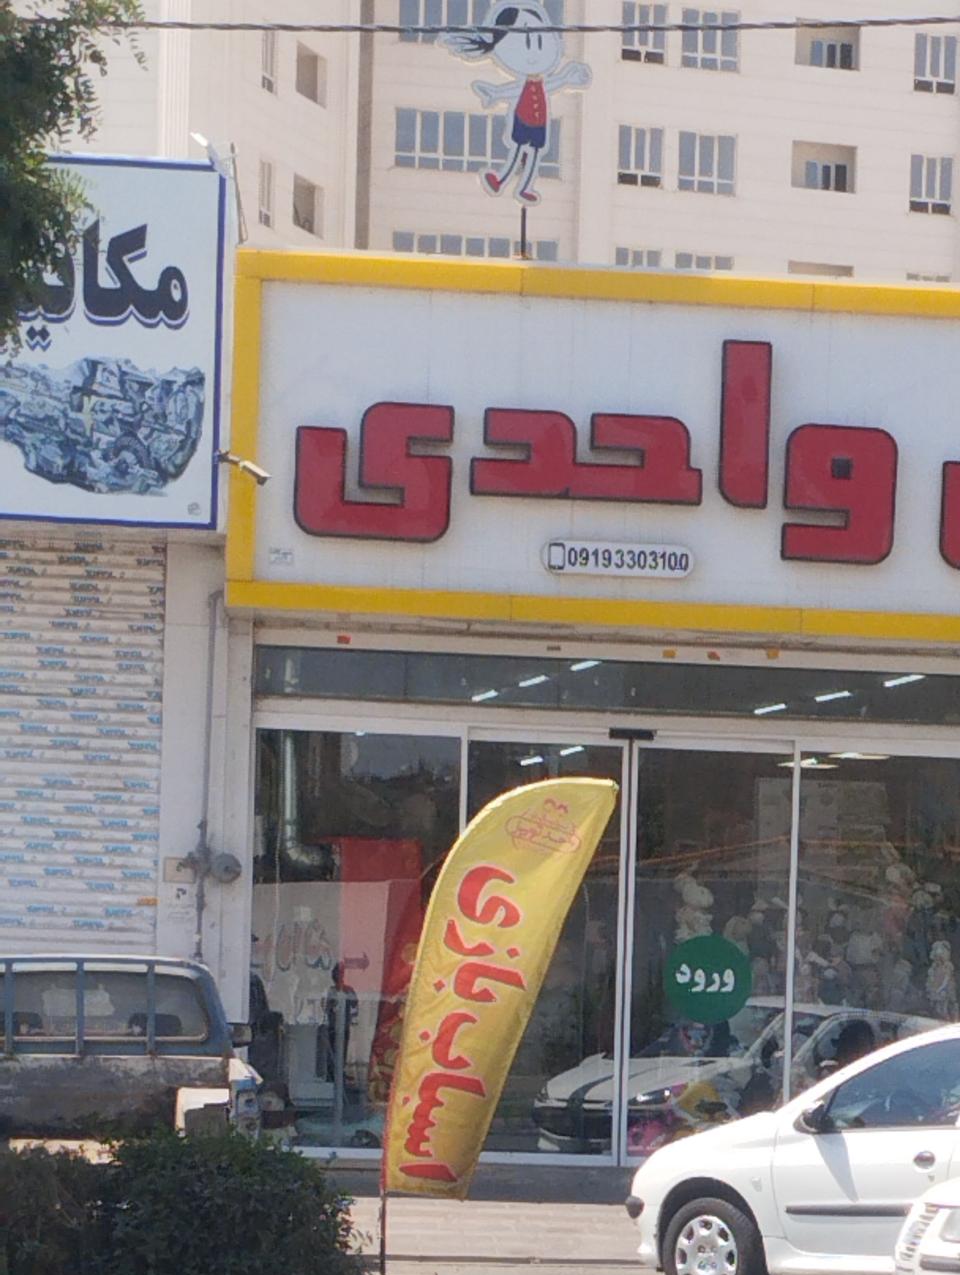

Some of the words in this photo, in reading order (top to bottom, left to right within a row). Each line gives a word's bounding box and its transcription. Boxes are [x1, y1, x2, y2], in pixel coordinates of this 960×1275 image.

[293, 339, 899, 566] واحدی
[567, 547, 690, 572] 09193303100
[432, 864, 529, 1003] بازی
[675, 963, 735, 993] ورود
[398, 1011, 488, 1182] اسباب
